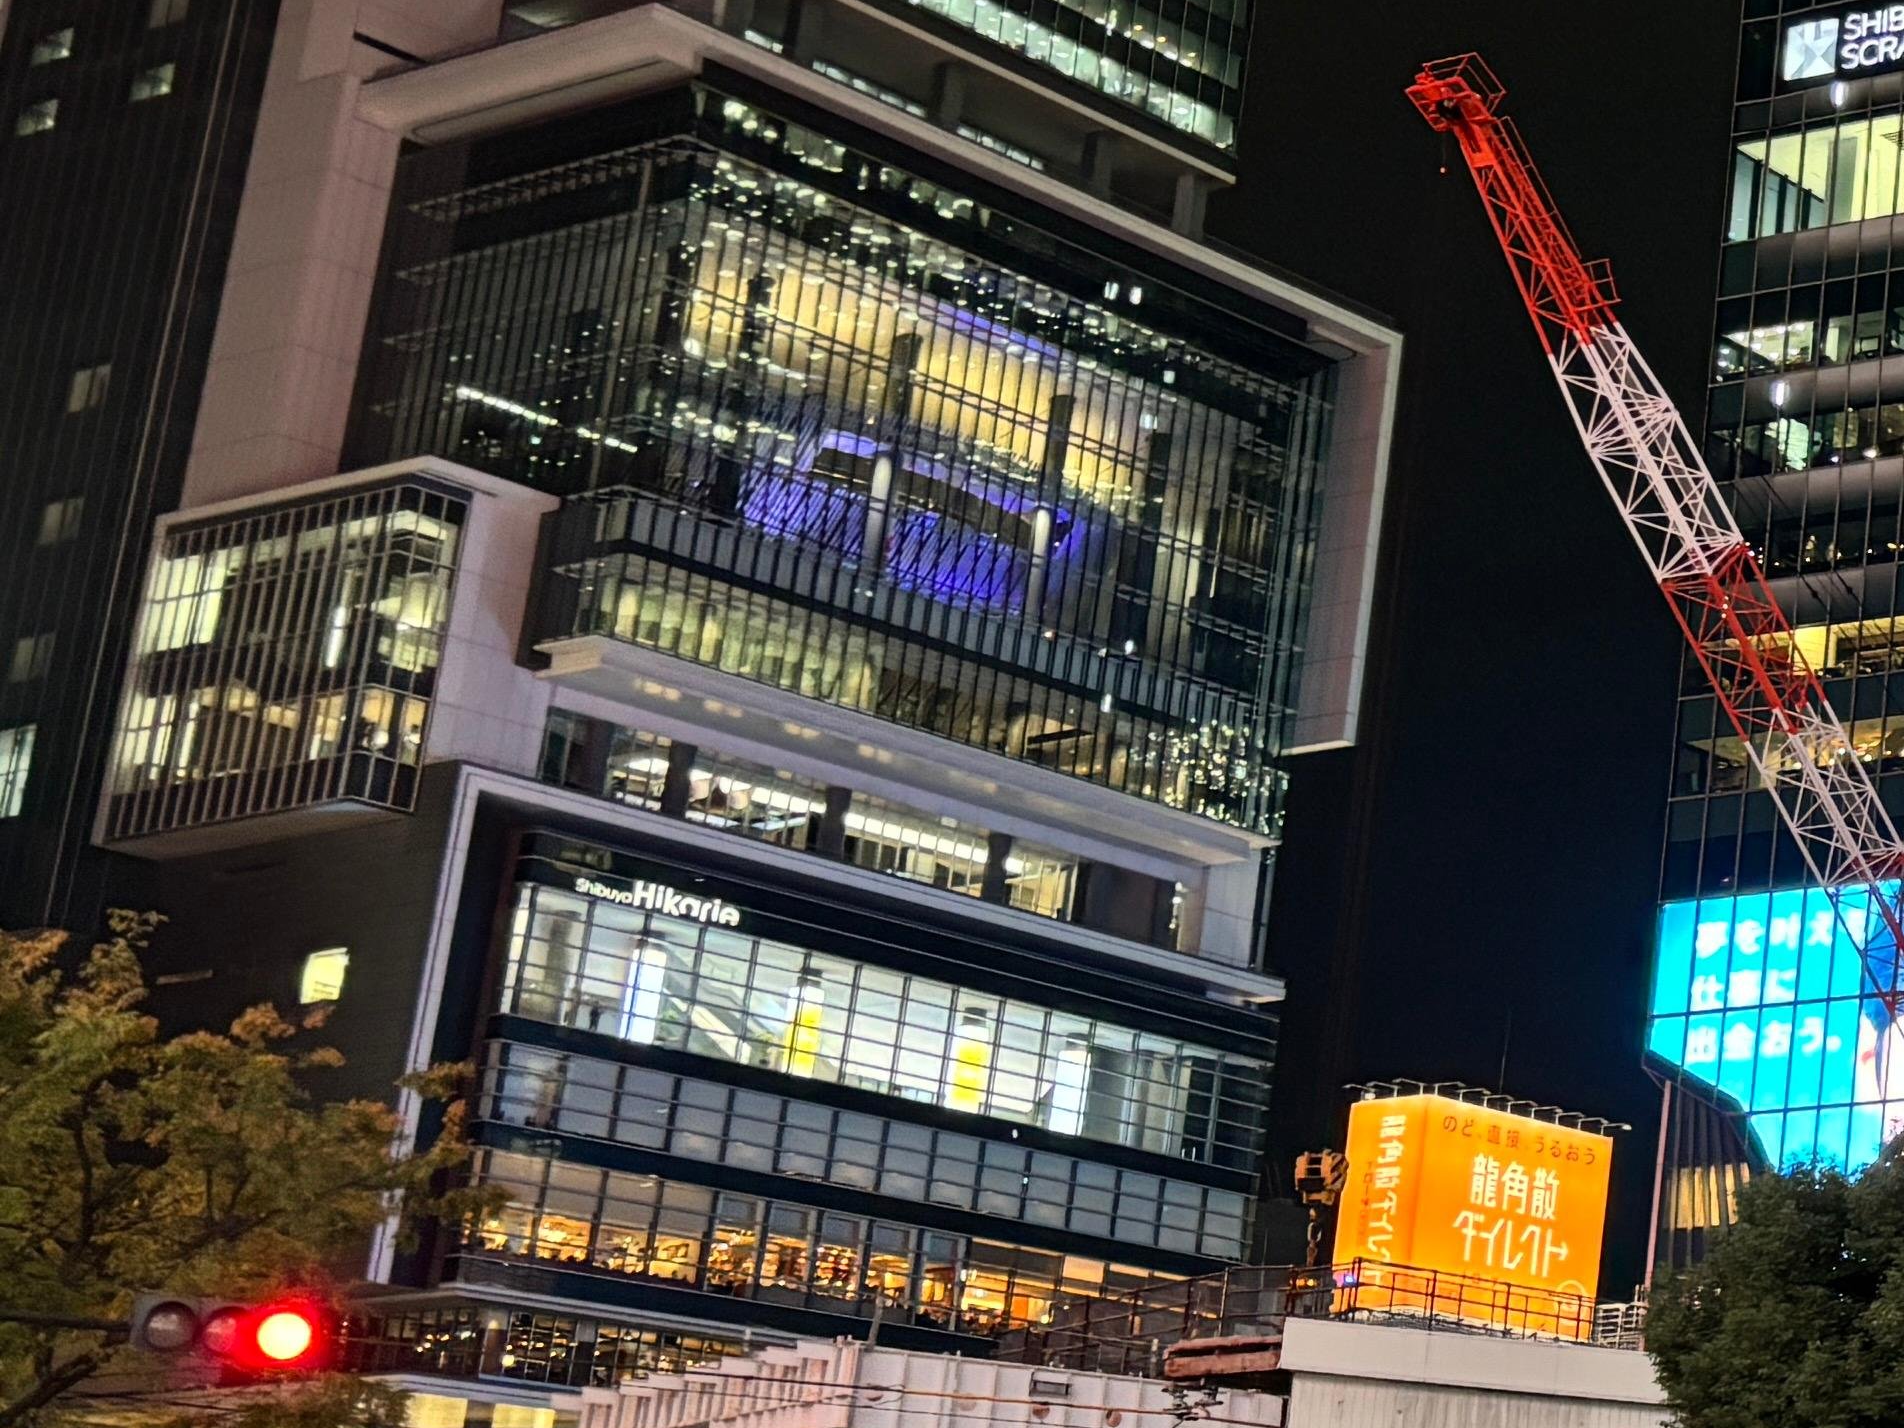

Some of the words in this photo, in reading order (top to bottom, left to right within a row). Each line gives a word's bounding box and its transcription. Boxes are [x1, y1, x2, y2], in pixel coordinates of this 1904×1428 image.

[632, 880, 741, 927] Hikarie
[1469, 1152, 1561, 1221] 龍角散
[1452, 1209, 1570, 1278] ダイレクト
